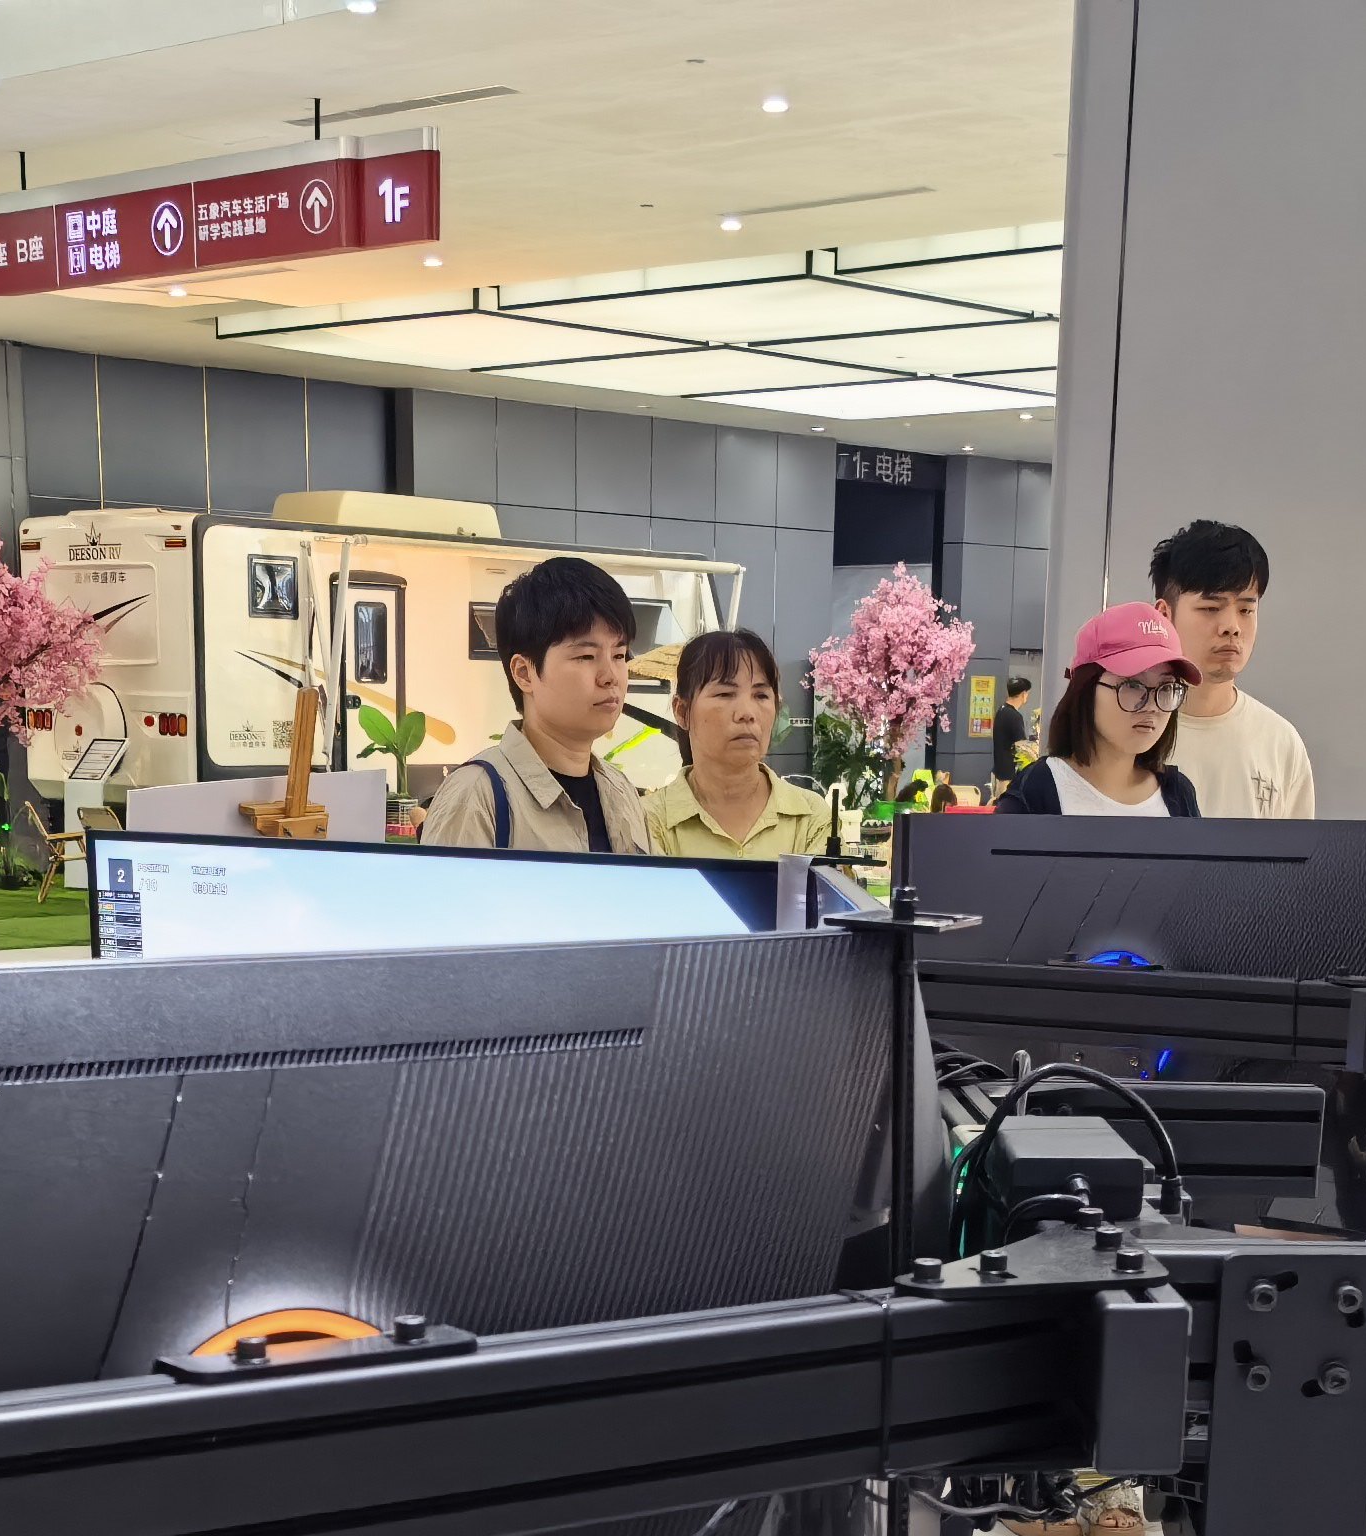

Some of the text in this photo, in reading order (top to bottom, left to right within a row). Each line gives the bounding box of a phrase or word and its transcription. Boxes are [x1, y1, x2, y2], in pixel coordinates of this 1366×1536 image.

[197, 191, 290, 222] 五象汽车生活广场
[378, 178, 410, 223] 1F
[85, 207, 118, 238] 中庭
[197, 215, 267, 242] 研学实践基地
[16, 235, 45, 263] B座
[89, 240, 121, 271] 电梯
[875, 451, 912, 486] 电梯
[68, 546, 122, 562] DEESON RV
[117, 869, 126, 883] 2
